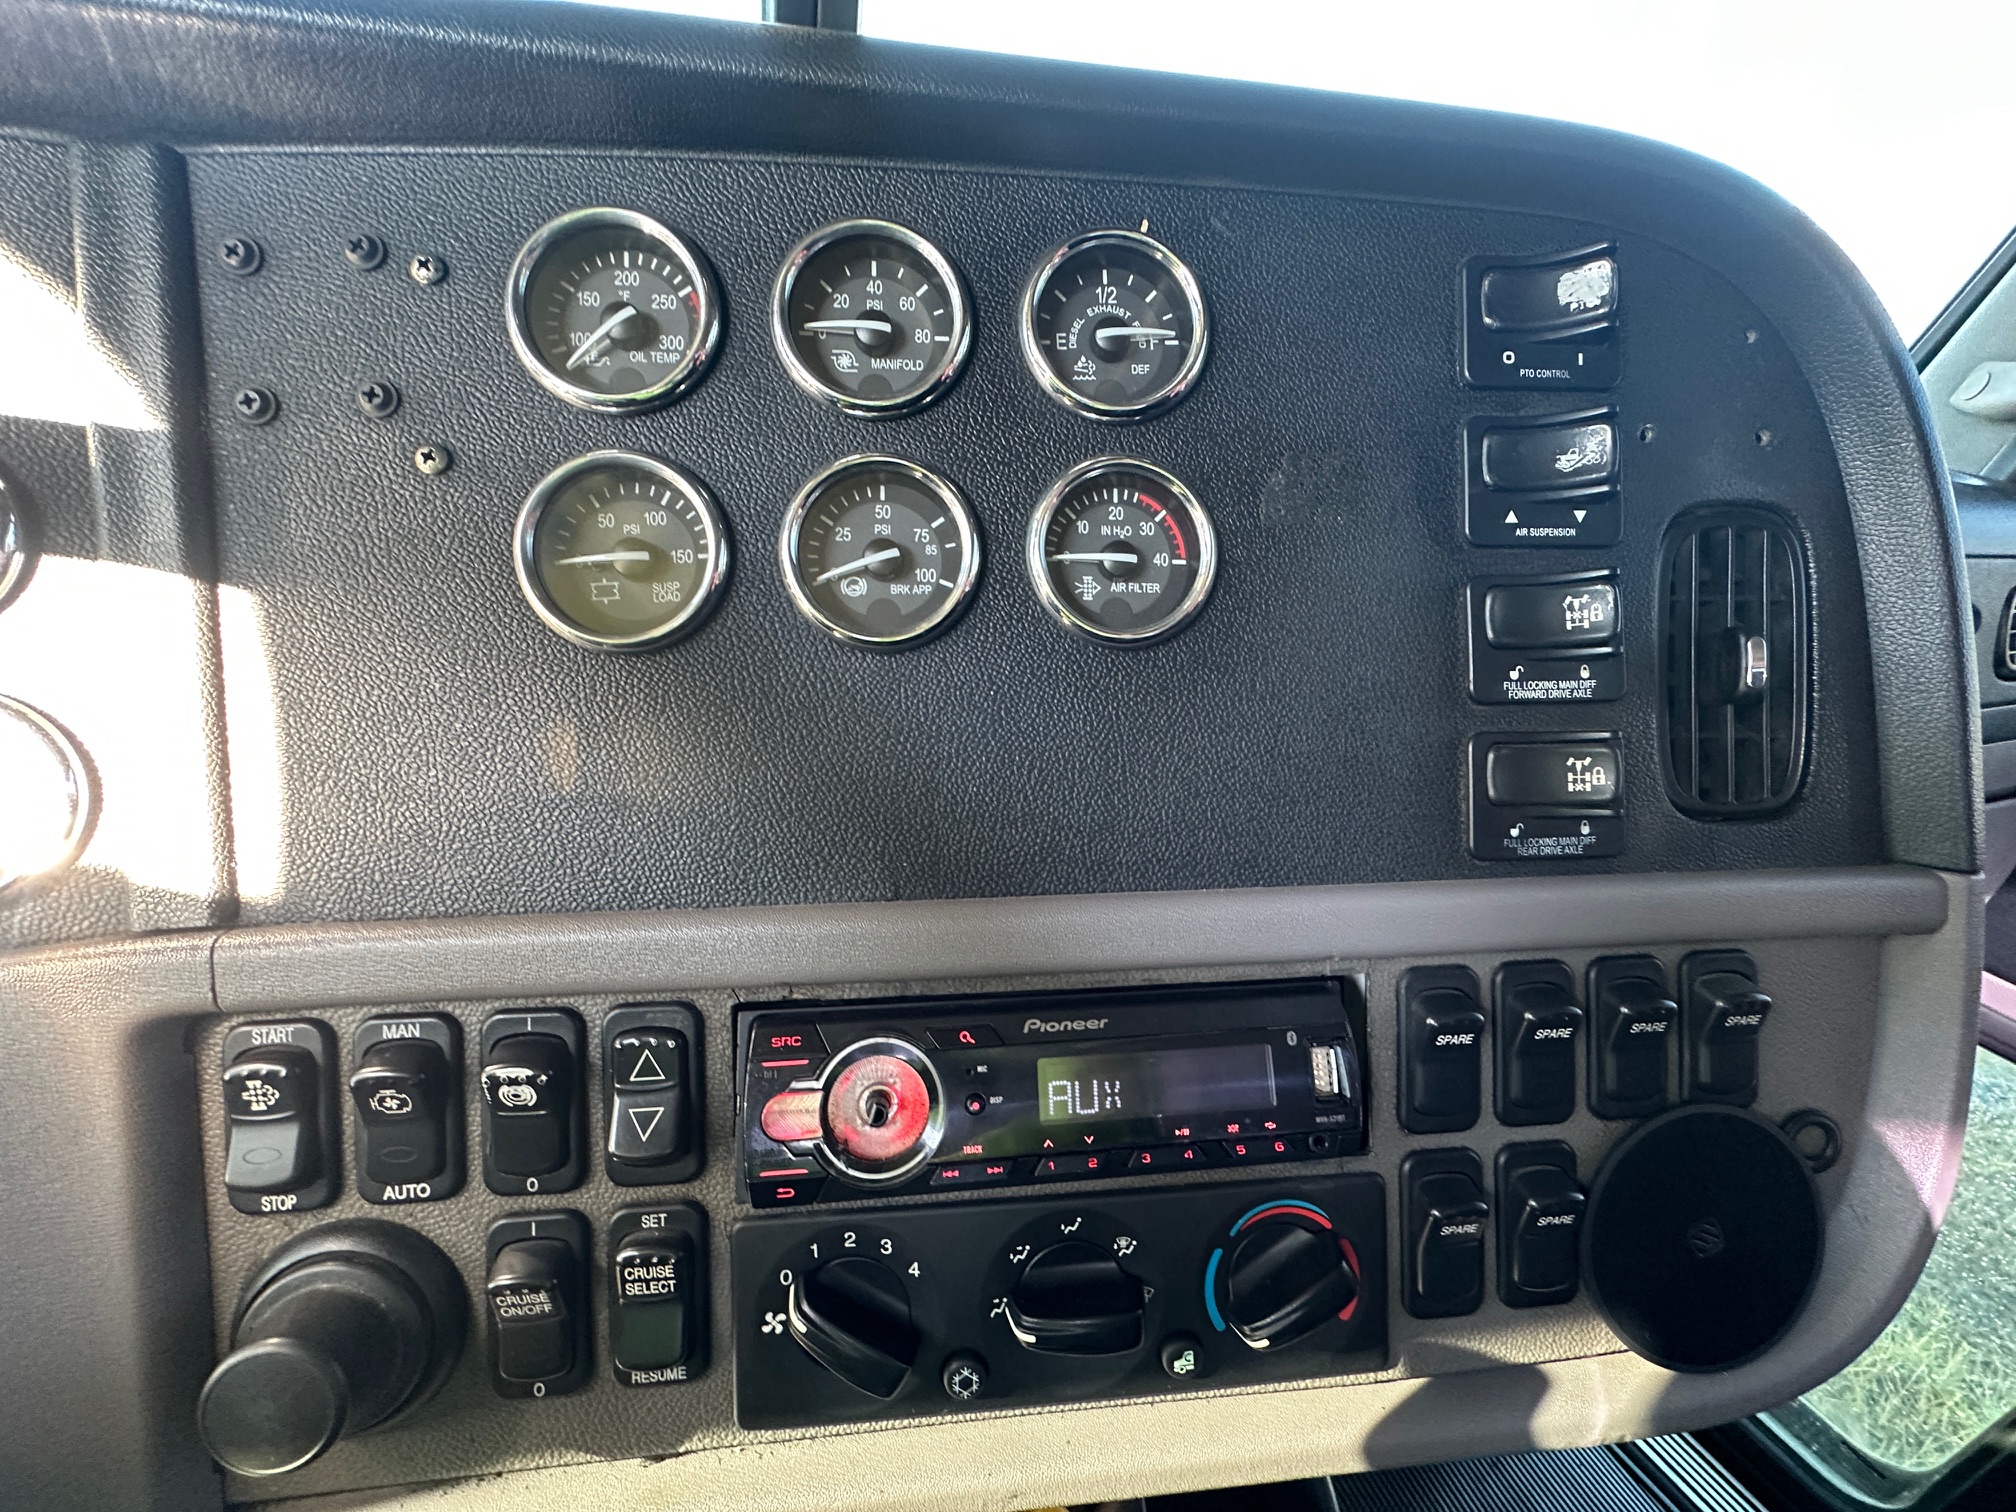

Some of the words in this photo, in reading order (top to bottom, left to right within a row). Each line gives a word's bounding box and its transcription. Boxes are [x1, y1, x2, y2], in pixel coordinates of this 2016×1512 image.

[614, 271, 640, 286] 200
[866, 280, 883, 295] 40
[577, 292, 600, 307] 150
[651, 295, 677, 309] 250
[833, 294, 849, 309] 20
[1096, 286, 1117, 304] 1/2
[866, 300, 883, 311] PSI
[899, 297, 915, 311] 60
[1069, 318, 1085, 349] DIESEL
[1087, 305, 1132, 320] EXHAUST
[659, 335, 684, 349] 300
[915, 329, 930, 343] 80
[1056, 333, 1067, 350] E
[630, 352, 647, 362] OIL
[651, 352, 680, 363] TEMP
[871, 358, 924, 371] MANIFOLD
[1131, 364, 1150, 374] DEF
[1520, 369, 1535, 378] PTO
[1536, 369, 1570, 379] CONTROL
[644, 512, 667, 526] 100
[875, 505, 891, 519] 50
[1109, 507, 1124, 521] 20
[598, 513, 615, 528] 50
[1076, 521, 1089, 534] 10
[623, 524, 640, 534] PSI
[835, 527, 851, 542] 25
[874, 524, 891, 535] PSI
[913, 528, 930, 542] 75
[1101, 526, 1111, 536] IN
[1139, 522, 1155, 536] 30
[1515, 528, 1528, 536] AIR
[1530, 528, 1576, 537] SUSPENSION
[671, 549, 694, 563] 150
[925, 545, 937, 555] 85
[1153, 553, 1169, 567] 40
[915, 568, 936, 583] 100
[652, 582, 680, 592] SUSP
[891, 584, 911, 595] BRK
[912, 584, 932, 594] APP
[1110, 583, 1127, 592] AIR
[1128, 583, 1160, 593] FILTER
[653, 592, 681, 602] LOAD
[1503, 681, 1522, 690] FULL
[1523, 680, 1557, 690] LOCKING
[1559, 680, 1578, 689] MAIN
[1580, 680, 1597, 688] DIFF
[1508, 690, 1547, 699] FORWARD
[1548, 690, 1572, 698] DRIVE
[1573, 689, 1592, 698] AXLE
[1503, 839, 1522, 848] FULL
[1523, 838, 1558, 847] LOCKING
[1559, 837, 1578, 846] MAIN
[1580, 836, 1597, 845] DIFF
[1517, 847, 1538, 856] REAR
[1540, 846, 1563, 855] DRIVE
[1564, 846, 1583, 854] AXLE
[1023, 1018, 1109, 1034] Pioneer
[1629, 1021, 1668, 1034] SPARE
[1724, 1014, 1762, 1027] SPARE
[251, 1027, 294, 1044] START
[382, 1024, 420, 1039] MAN
[1534, 1027, 1573, 1040] SPARE
[771, 1036, 802, 1048] SRC
[1435, 1033, 1475, 1046] SPARE
[990, 1096, 1003, 1104] DISP
[1048, 1079, 1121, 1115] AUX
[963, 1145, 983, 1154] TRACK
[1184, 1149, 1193, 1159] 4
[1236, 1145, 1246, 1155] 5
[1088, 1157, 1097, 1168] 2
[1141, 1153, 1151, 1163] 3
[1048, 1161, 1055, 1170] 1
[383, 1183, 431, 1201] AUTO
[261, 1194, 297, 1212] STOP
[641, 1213, 668, 1228] SET
[1537, 1214, 1576, 1227] SPARE
[1440, 1223, 1479, 1236] SPARE
[844, 1232, 856, 1247] 2
[880, 1238, 892, 1254] 3
[810, 1243, 818, 1258] 1
[624, 1265, 675, 1280] CRUISE
[908, 1262, 920, 1277] 4
[780, 1269, 793, 1285] 0
[625, 1280, 677, 1296] SELECT
[495, 1292, 550, 1307] CRUISE
[500, 1303, 553, 1318] ON/OFF
[631, 1366, 687, 1384] RESUME
